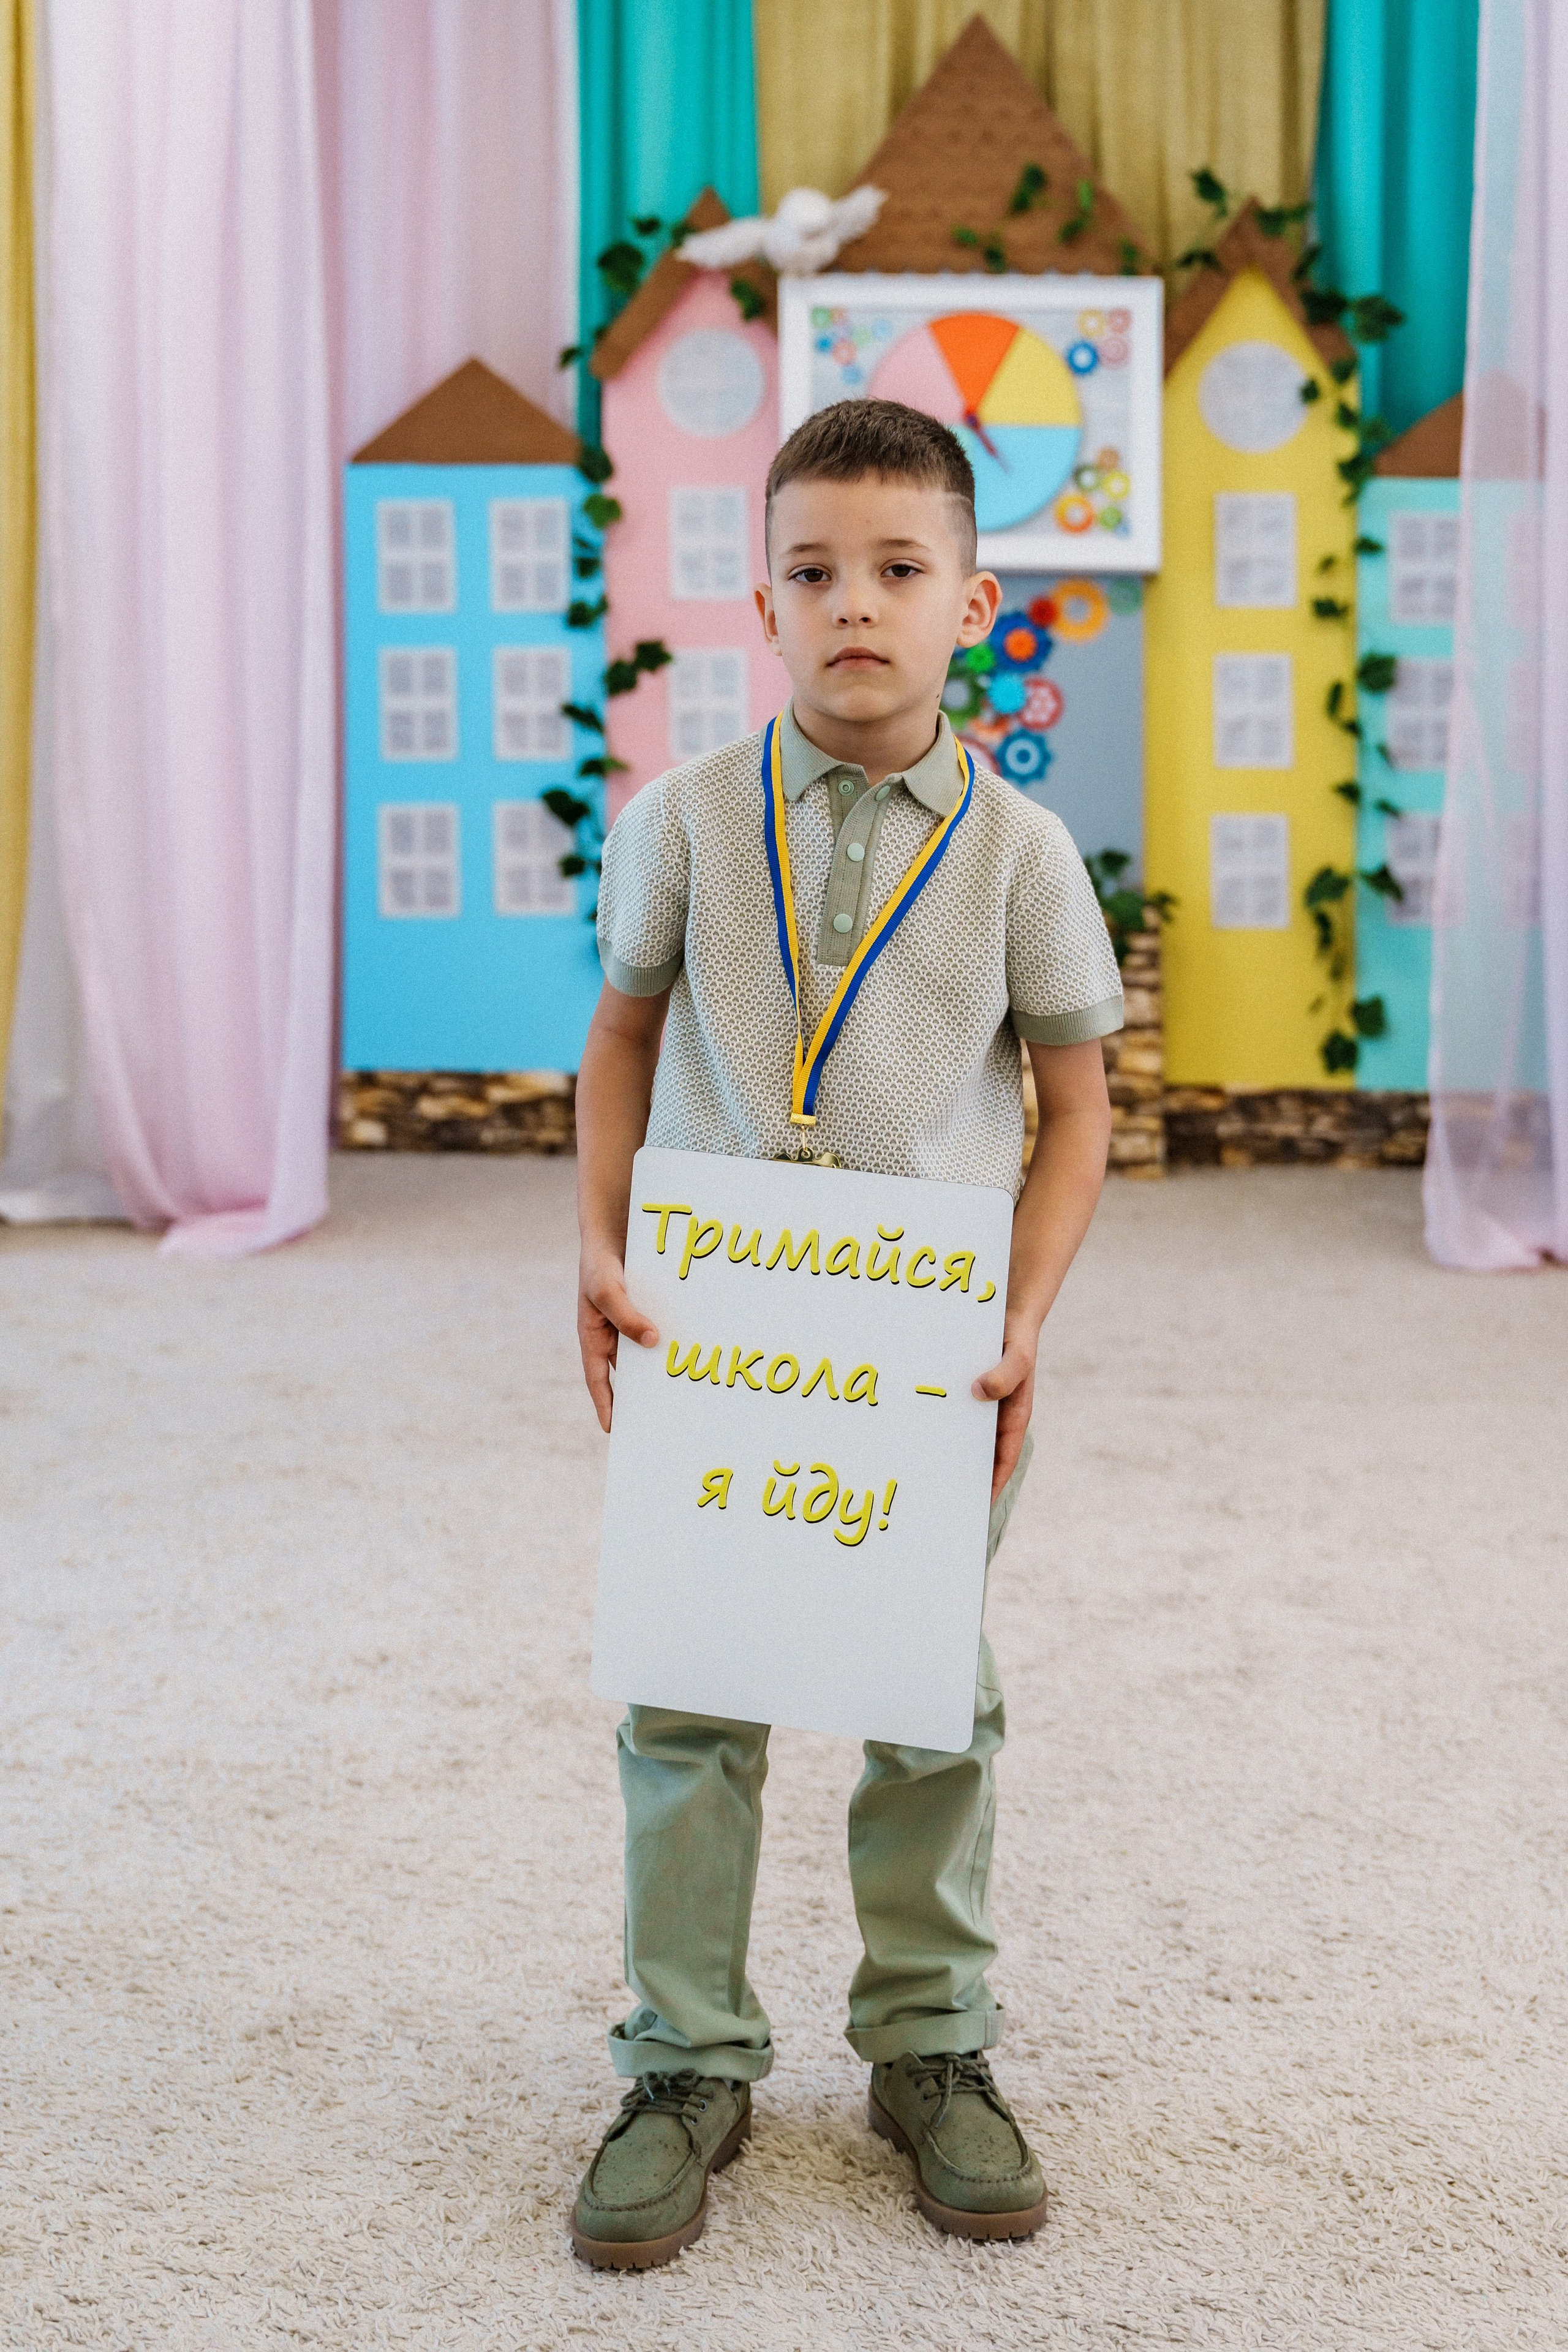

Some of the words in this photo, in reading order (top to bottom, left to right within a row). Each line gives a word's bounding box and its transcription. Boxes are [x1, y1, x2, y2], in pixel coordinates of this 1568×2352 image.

[641, 1203, 996, 1303] Тримайся,
[665, 1340, 879, 1406] школа
[697, 1468, 734, 1510] я
[761, 1459, 898, 1547] йду!
